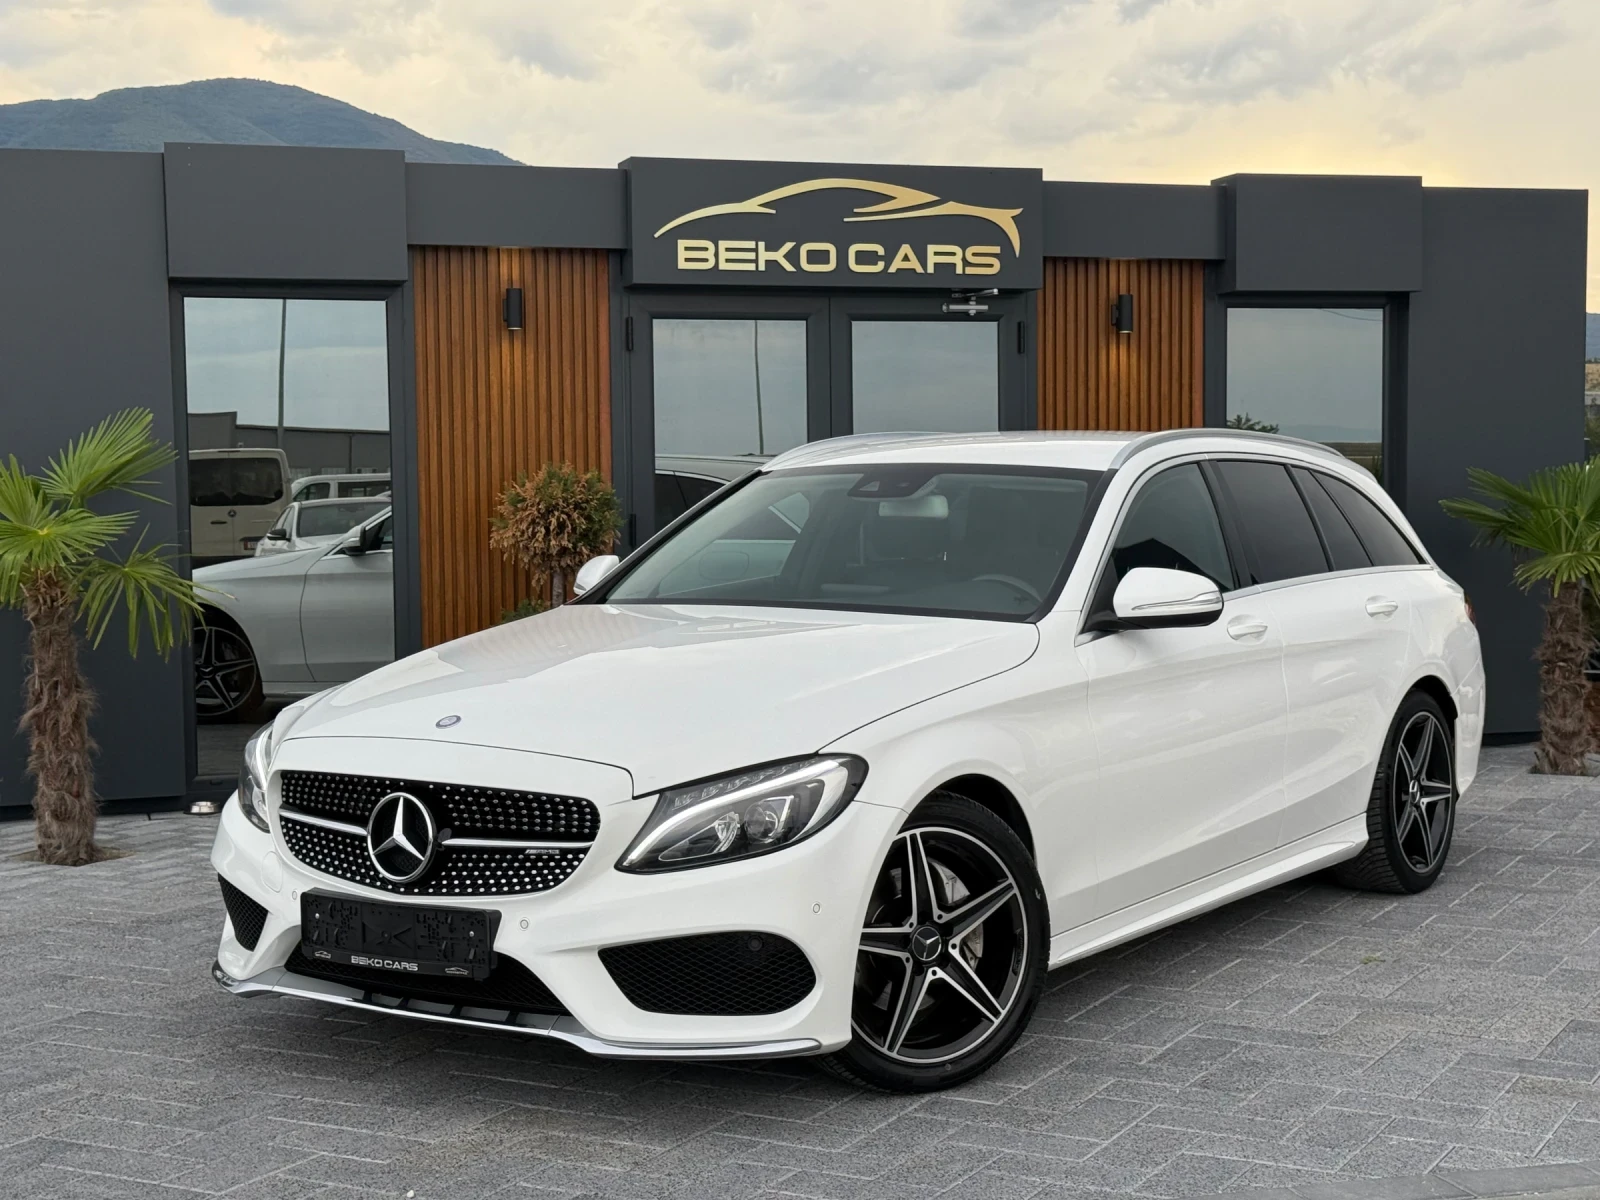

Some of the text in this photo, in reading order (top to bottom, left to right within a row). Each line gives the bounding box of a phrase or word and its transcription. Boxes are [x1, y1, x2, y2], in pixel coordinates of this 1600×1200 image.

[677, 239, 1001, 275] BEKO CARS
[351, 956, 418, 971] BEKO CARS
